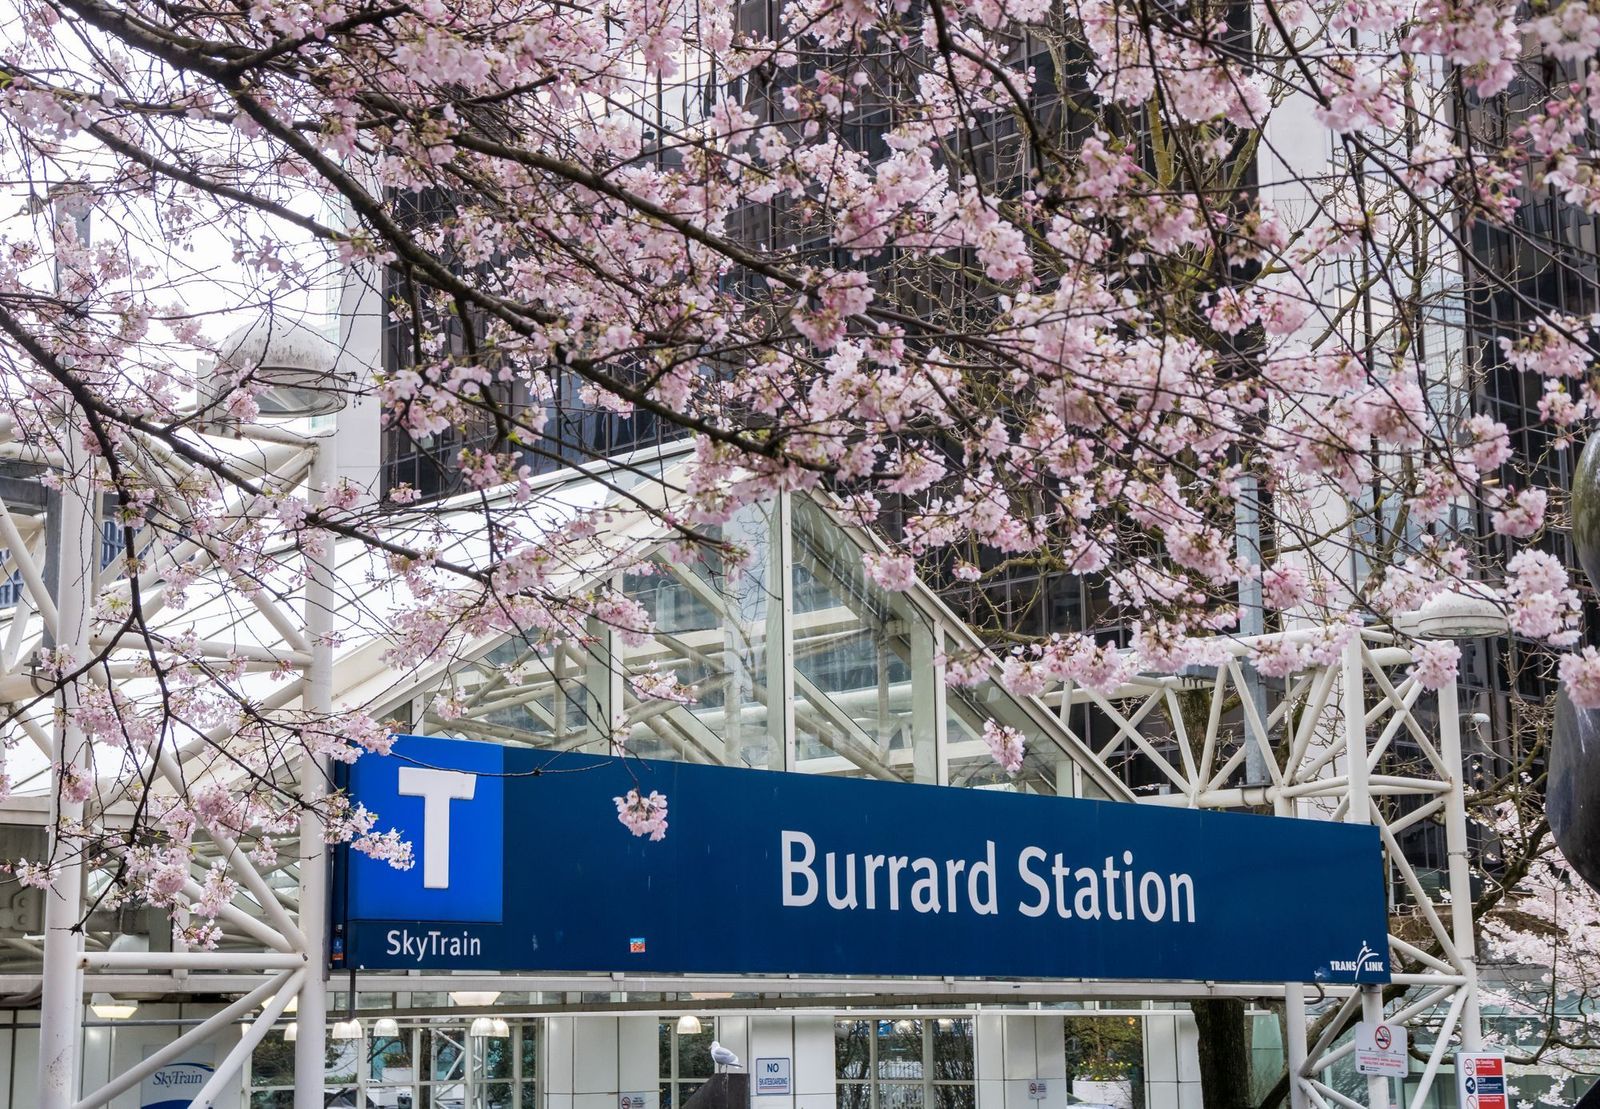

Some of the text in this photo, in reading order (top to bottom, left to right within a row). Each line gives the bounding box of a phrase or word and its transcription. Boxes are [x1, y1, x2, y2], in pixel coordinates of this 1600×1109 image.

[398, 767, 477, 889] T
[781, 830, 1196, 924] Burrard Station
[386, 929, 481, 962] SkyTrain
[1330, 961, 1384, 972] TRANS LINK
[153, 1070, 203, 1088] SkyTrain
[767, 1063, 779, 1073] NO
